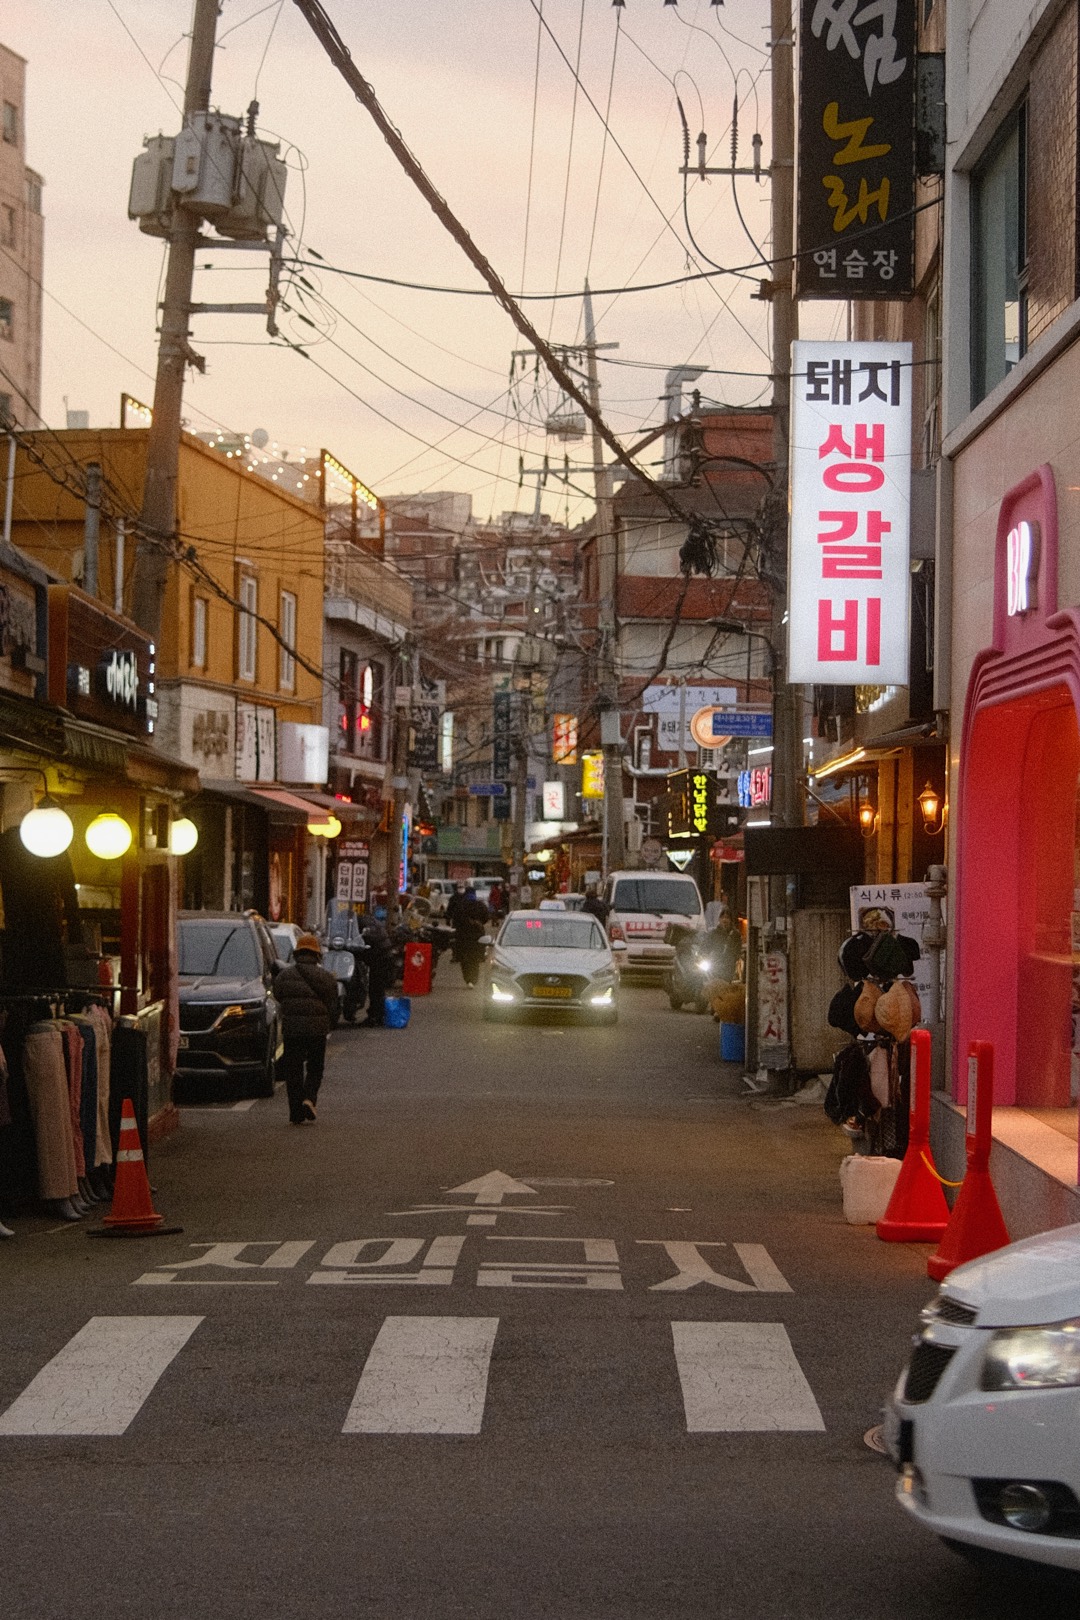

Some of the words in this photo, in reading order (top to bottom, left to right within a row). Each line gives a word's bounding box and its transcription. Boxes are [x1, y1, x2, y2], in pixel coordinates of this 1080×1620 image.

[822, 101, 892, 232] 노래
[813, 249, 899, 280] 연습장
[805, 359, 901, 407] 돼지
[816, 423, 892, 666] 생갈비
[545, 791, 560, 811] 꽃
[693, 774, 708, 832] 한남닭발
[339, 865, 350, 897] 단체석
[355, 866, 365, 898] 야외석
[860, 889, 902, 902] 식사류
[129, 1235, 795, 1294] 진입금지
